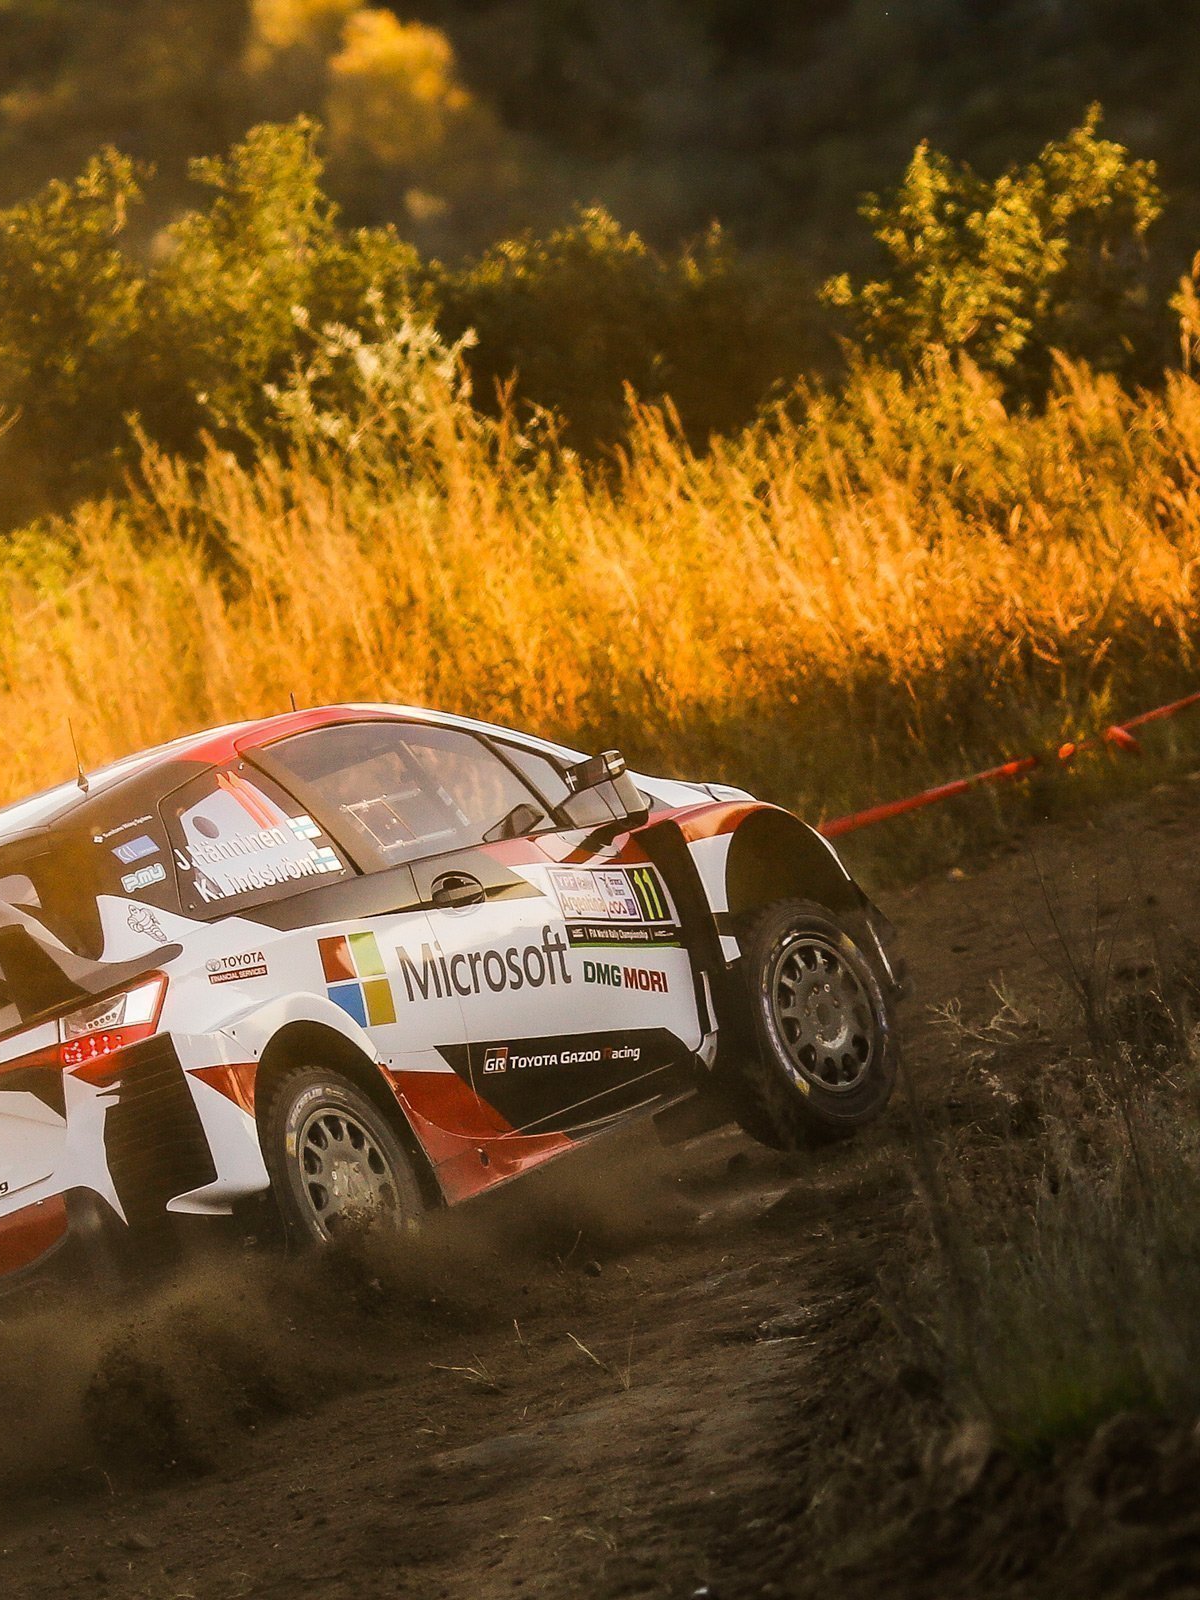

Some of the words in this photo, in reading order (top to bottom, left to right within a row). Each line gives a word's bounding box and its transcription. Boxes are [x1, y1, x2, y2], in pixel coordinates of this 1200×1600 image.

[560, 891, 607, 915] Argentina
[633, 868, 664, 920] 11
[589, 928, 597, 938] FIA
[597, 928, 608, 938] World
[609, 929, 619, 940] Rally
[619, 929, 649, 940] Championship
[221, 951, 266, 968] TOYOTA
[395, 925, 572, 1001] Microsoft
[210, 971, 239, 984] FINANCIAL
[239, 966, 267, 978] SERVICES
[583, 960, 621, 987] DMG
[623, 967, 669, 993] MORI
[485, 1057, 506, 1072] GR
[510, 1055, 558, 1070] TOYOTA
[560, 1050, 601, 1064] GAZOO
[604, 1045, 641, 1062] Racing
